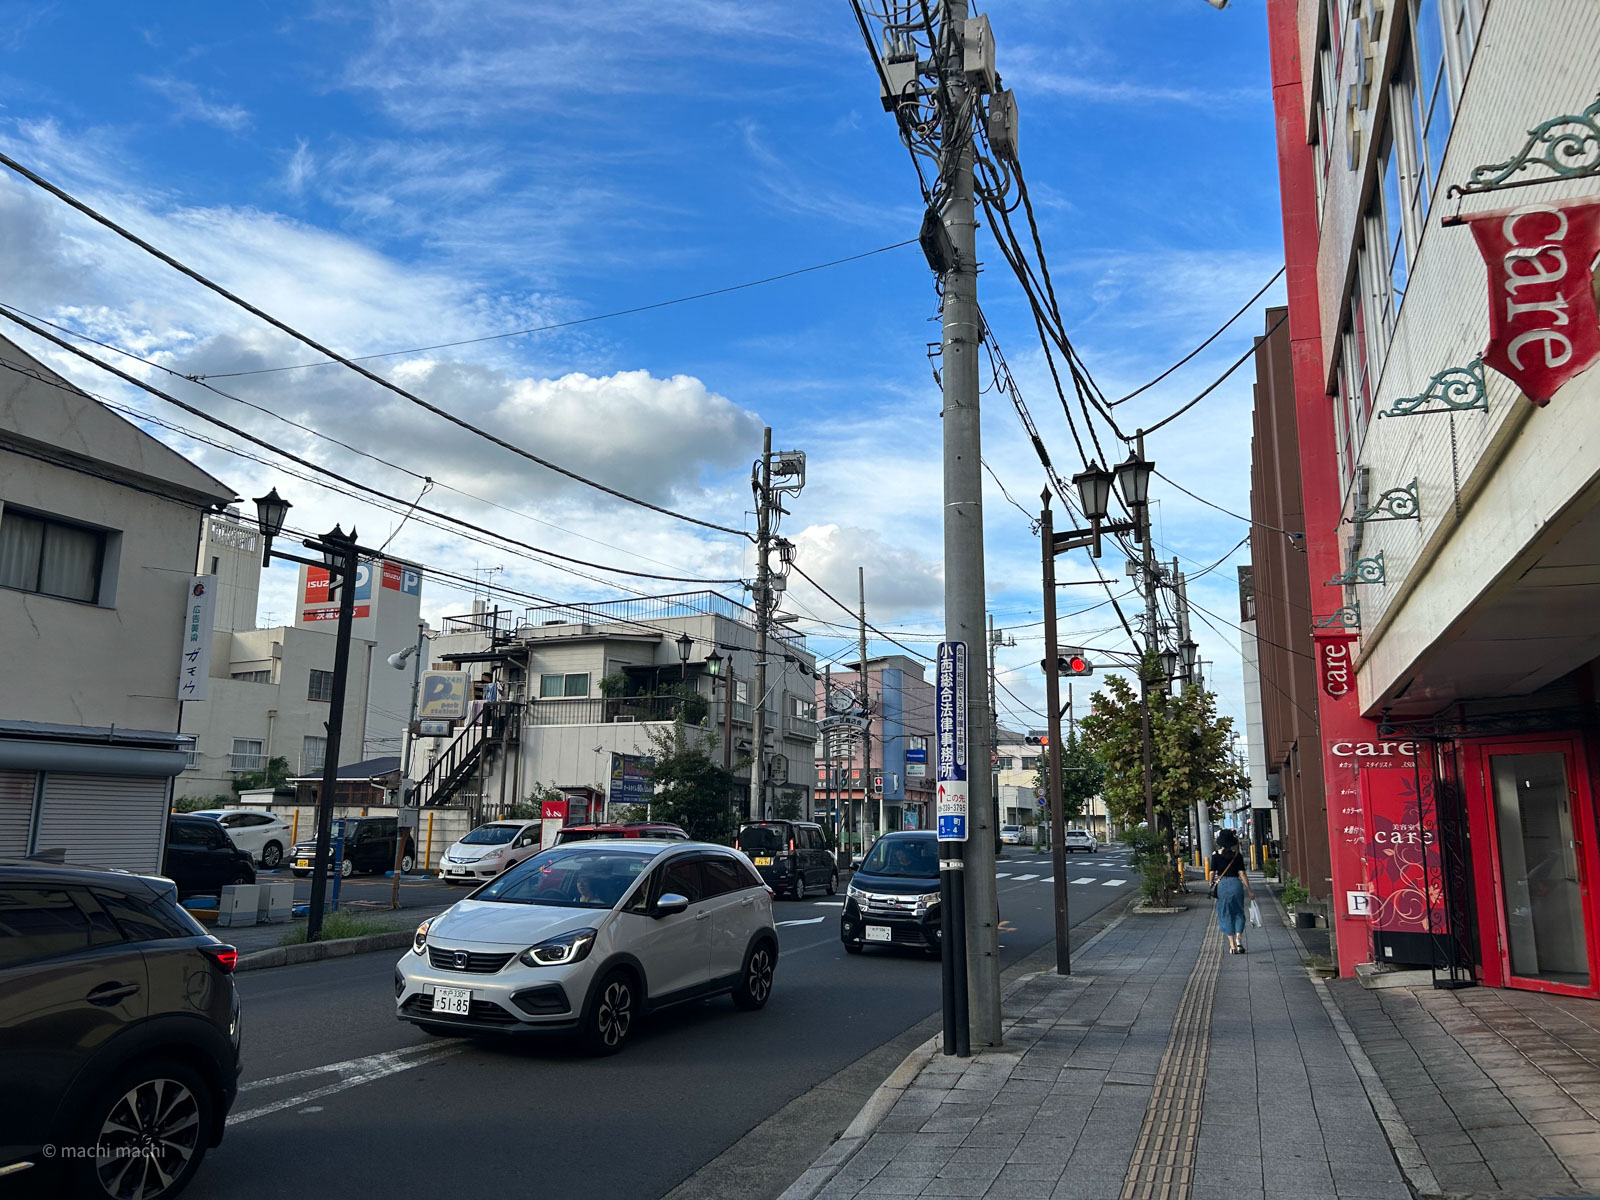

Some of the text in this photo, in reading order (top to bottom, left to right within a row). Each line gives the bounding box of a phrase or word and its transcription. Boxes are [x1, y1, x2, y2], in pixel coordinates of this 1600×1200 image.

[1502, 203, 1573, 372] care
[383, 572, 401, 581] ISUZU
[403, 571, 418, 592] P
[307, 580, 330, 589] ISUZ
[1325, 644, 1348, 696] care
[940, 643, 954, 778] 小西総合法律事務所
[1332, 741, 1420, 756] care
[946, 794, 966, 803] この先
[1374, 831, 1433, 844] care
[441, 997, 469, 1012] 51-85
